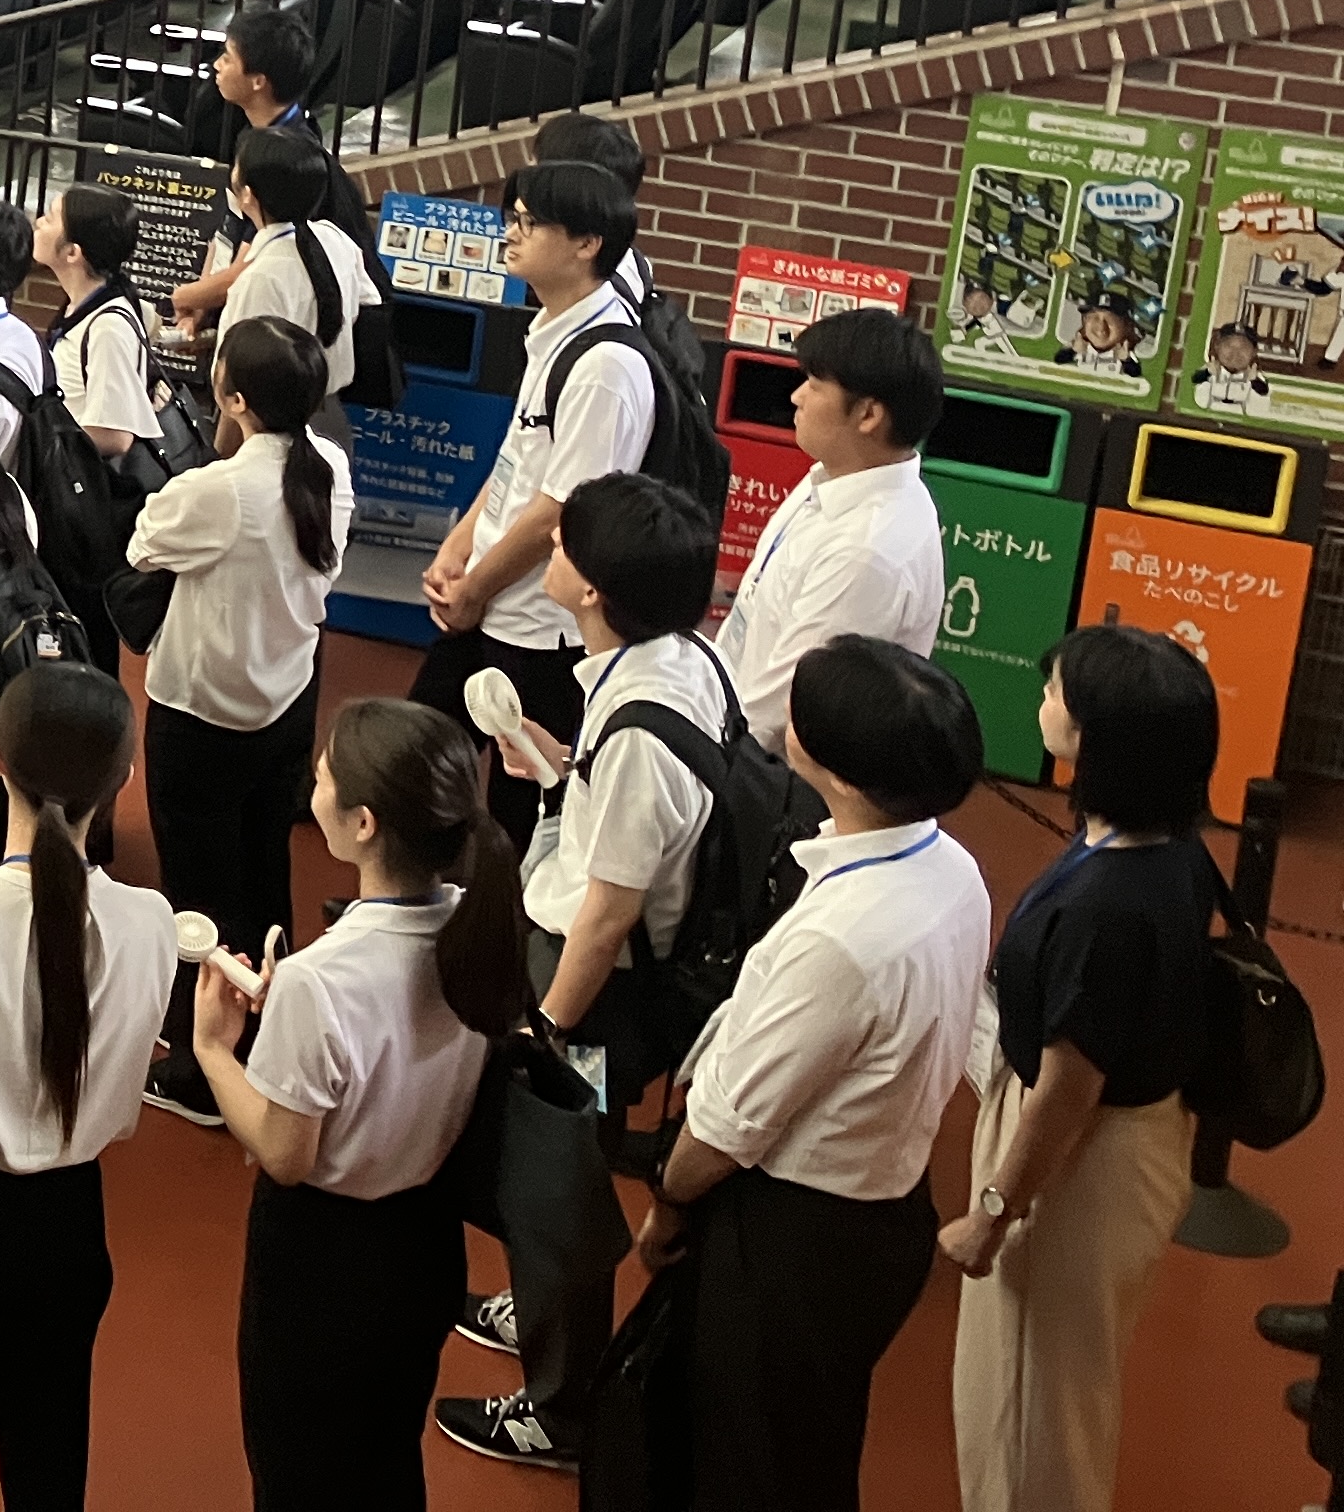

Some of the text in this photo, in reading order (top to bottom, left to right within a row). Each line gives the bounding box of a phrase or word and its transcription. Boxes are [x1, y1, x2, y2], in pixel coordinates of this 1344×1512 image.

[424, 202, 495, 222] プラスチック
[941, 524, 1052, 563] トボトル
[1110, 550, 1283, 598] 食品リサイクル
[1144, 580, 1239, 612] たべのこし
